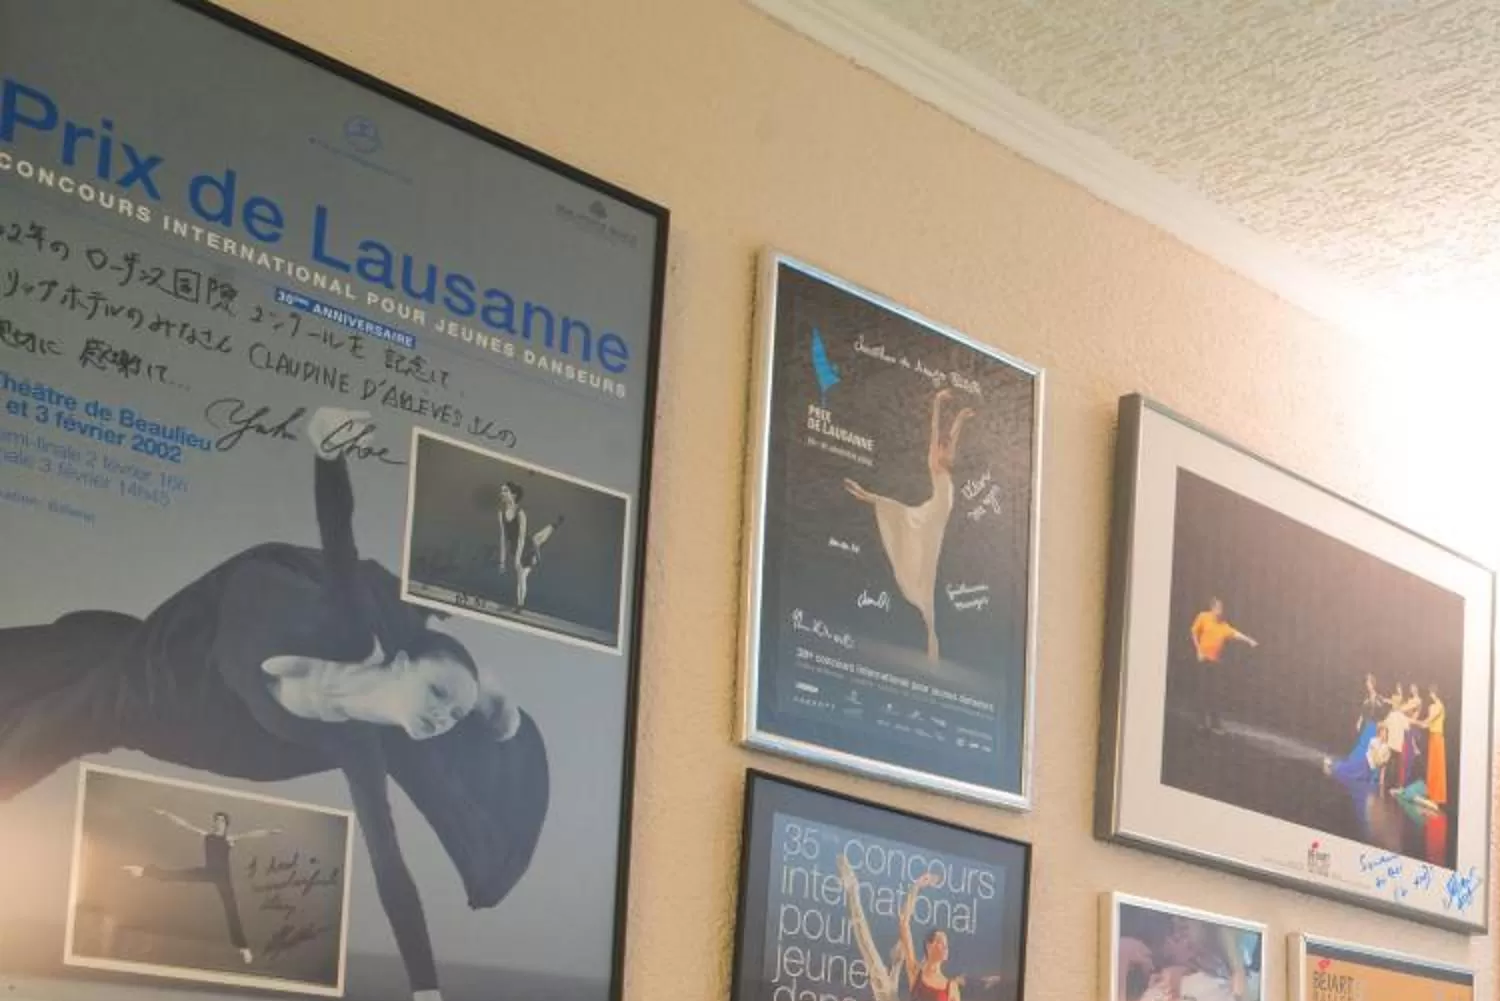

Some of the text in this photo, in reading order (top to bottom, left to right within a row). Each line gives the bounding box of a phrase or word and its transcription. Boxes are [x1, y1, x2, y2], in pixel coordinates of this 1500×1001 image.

[0, 78, 164, 200] Prix
[188, 168, 284, 243] de
[311, 203, 630, 375] Lausanne
[0, 152, 627, 399] CONCOURS INTERNATIONAL POUR JEUNES DANSEURS
[312, 304, 414, 347] ANNIVERSAIRE
[35, 405, 49, 424] 3
[131, 433, 183, 463] 2002
[85, 399, 113, 422] de
[119, 407, 212, 452] Beaulieu
[780, 858, 977, 934] intenatonal
[843, 838, 995, 900] concours
[777, 903, 853, 946] pour
[771, 941, 871, 990] jeune
